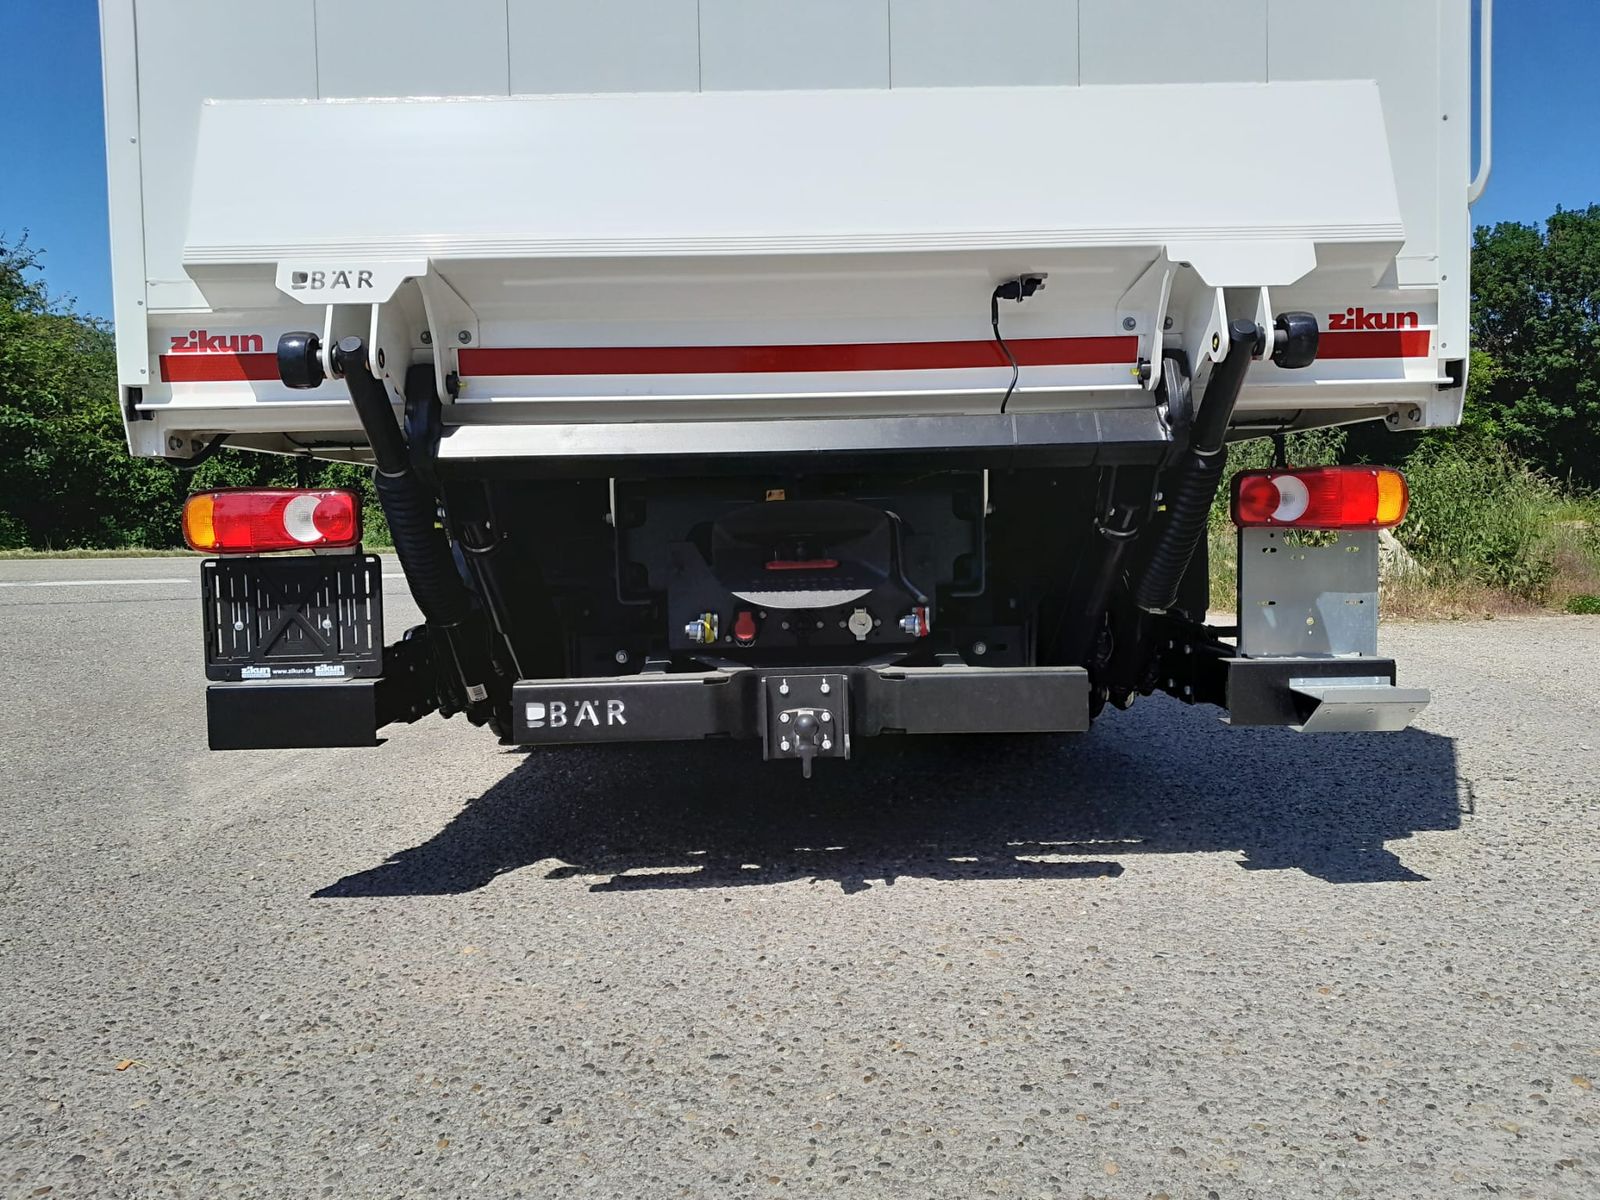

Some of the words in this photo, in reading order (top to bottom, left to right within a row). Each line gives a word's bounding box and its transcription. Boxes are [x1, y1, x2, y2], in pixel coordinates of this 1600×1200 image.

[310, 270, 374, 290] BÄR
[1328, 307, 1419, 331] zikun
[170, 330, 263, 353] zikun
[241, 666, 271, 674] zikun
[315, 664, 344, 673] zikun
[549, 699, 628, 728] BÄR
